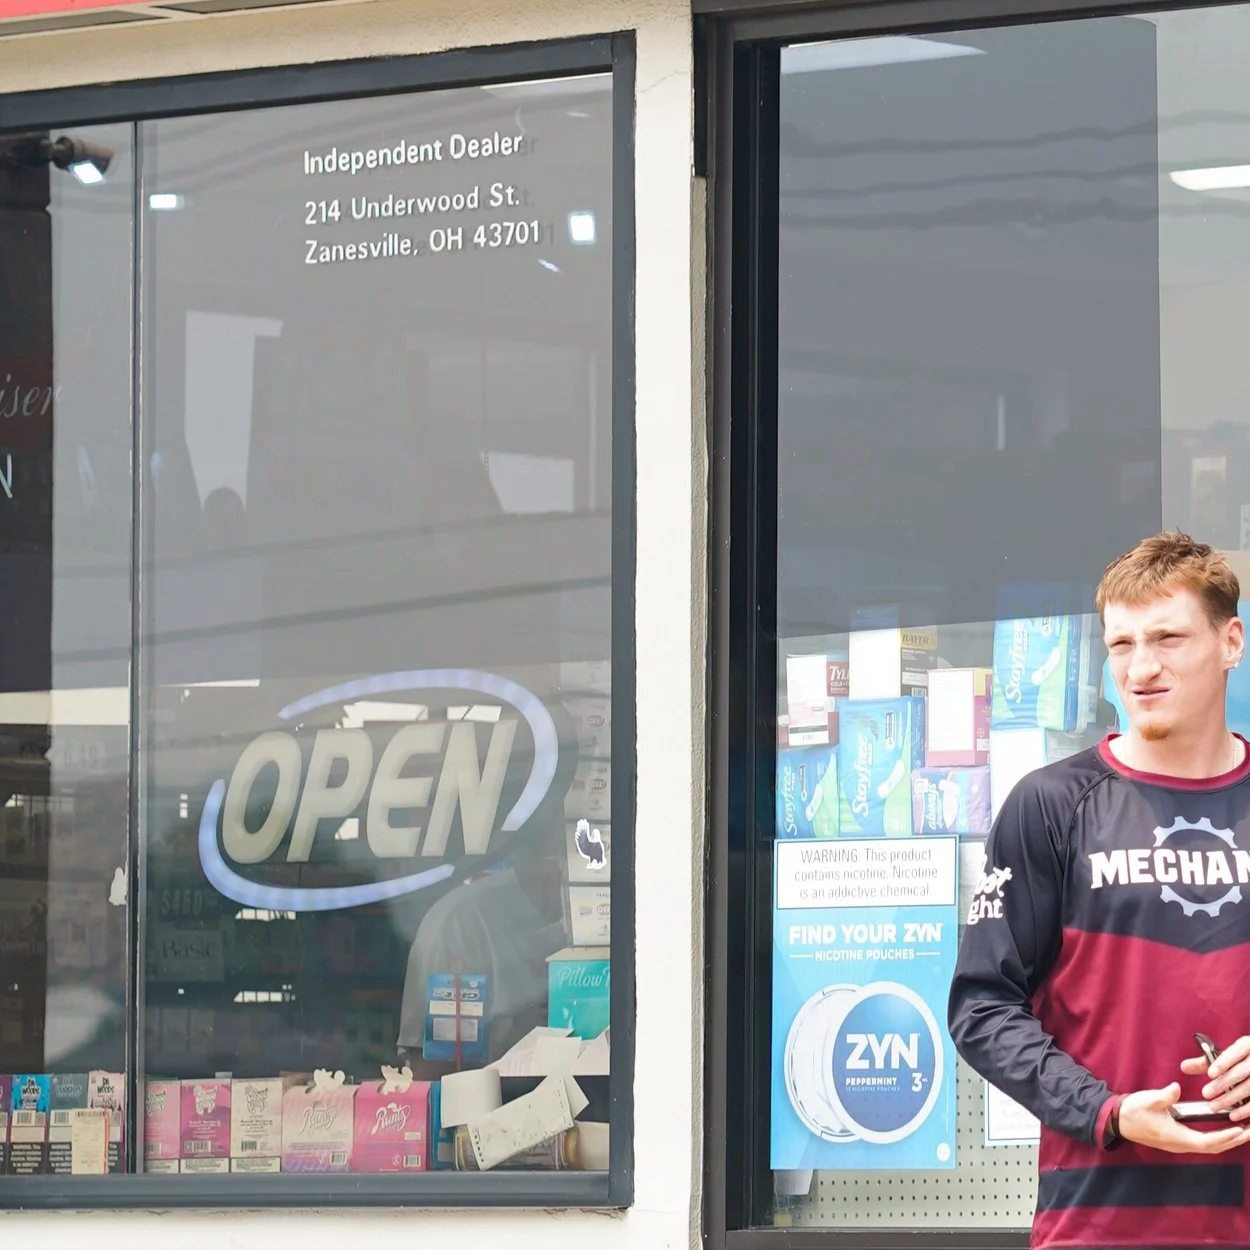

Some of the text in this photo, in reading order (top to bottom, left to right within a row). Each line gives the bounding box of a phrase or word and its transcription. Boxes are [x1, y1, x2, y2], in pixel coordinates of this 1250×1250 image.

[304, 131, 523, 175] Independent Dealer
[304, 183, 520, 225] 214 Underwood St.
[429, 227, 463, 252] OH
[473, 220, 540, 248] 43701
[902, 634, 930, 645] BAYER
[1004, 617, 1027, 705] Stayfree
[222, 721, 519, 864] OPEN
[851, 735, 869, 818] Stayfree
[781, 766, 797, 836] Stayfree
[801, 848, 932, 864] WARNING: This product
[795, 869, 840, 882] contains
[893, 865, 938, 880] Nicotine
[800, 888, 809, 900] is
[812, 888, 825, 899] an
[828, 885, 877, 899] addictive
[789, 922, 943, 945] FIND YOUR ZYN
[815, 948, 915, 962] NICOTINE POUCHES
[845, 1033, 919, 1070] ZYN
[846, 1072, 923, 1092] PEPPERMINT 3
